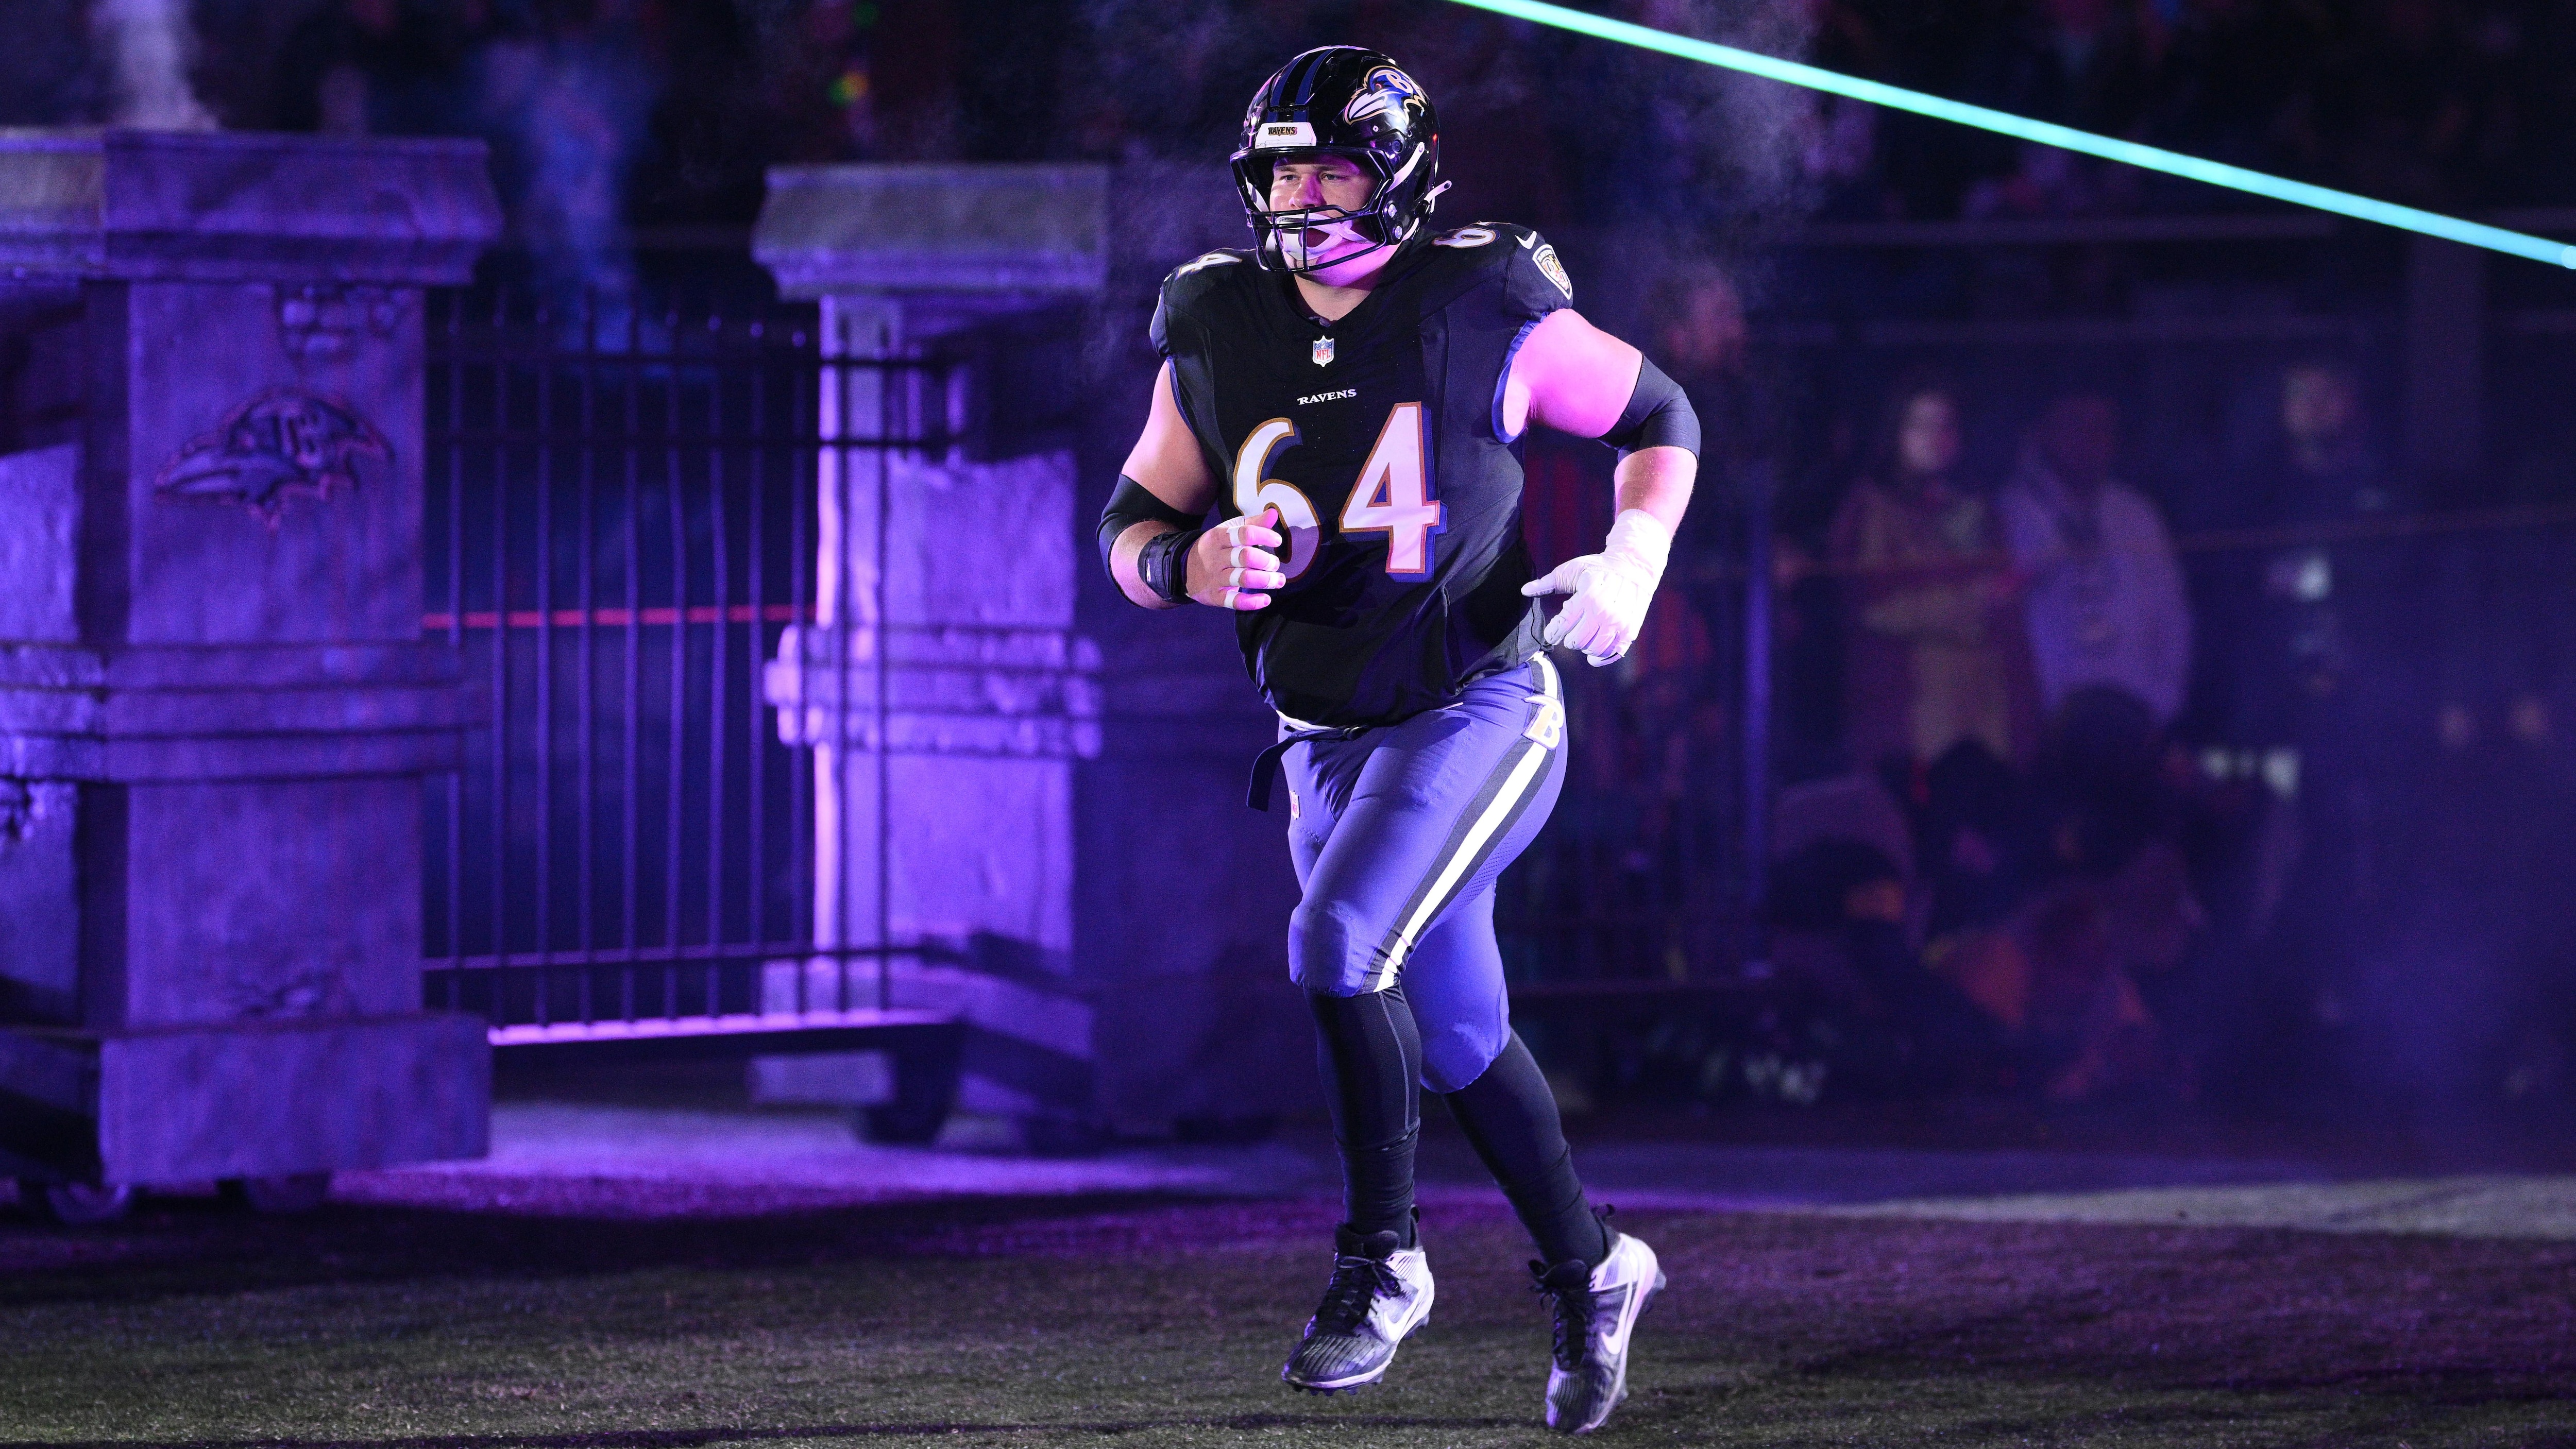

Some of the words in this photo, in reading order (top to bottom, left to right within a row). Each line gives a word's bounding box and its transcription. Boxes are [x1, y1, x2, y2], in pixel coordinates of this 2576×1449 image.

[1268, 127, 1298, 136] RAVENS
[1432, 224, 1500, 248] 6
[1176, 250, 1246, 277] 4
[1316, 349, 1331, 360] NFL
[1297, 388, 1358, 405] RAVENS
[1233, 401, 1445, 583] 64
[1521, 694, 1565, 751] B
